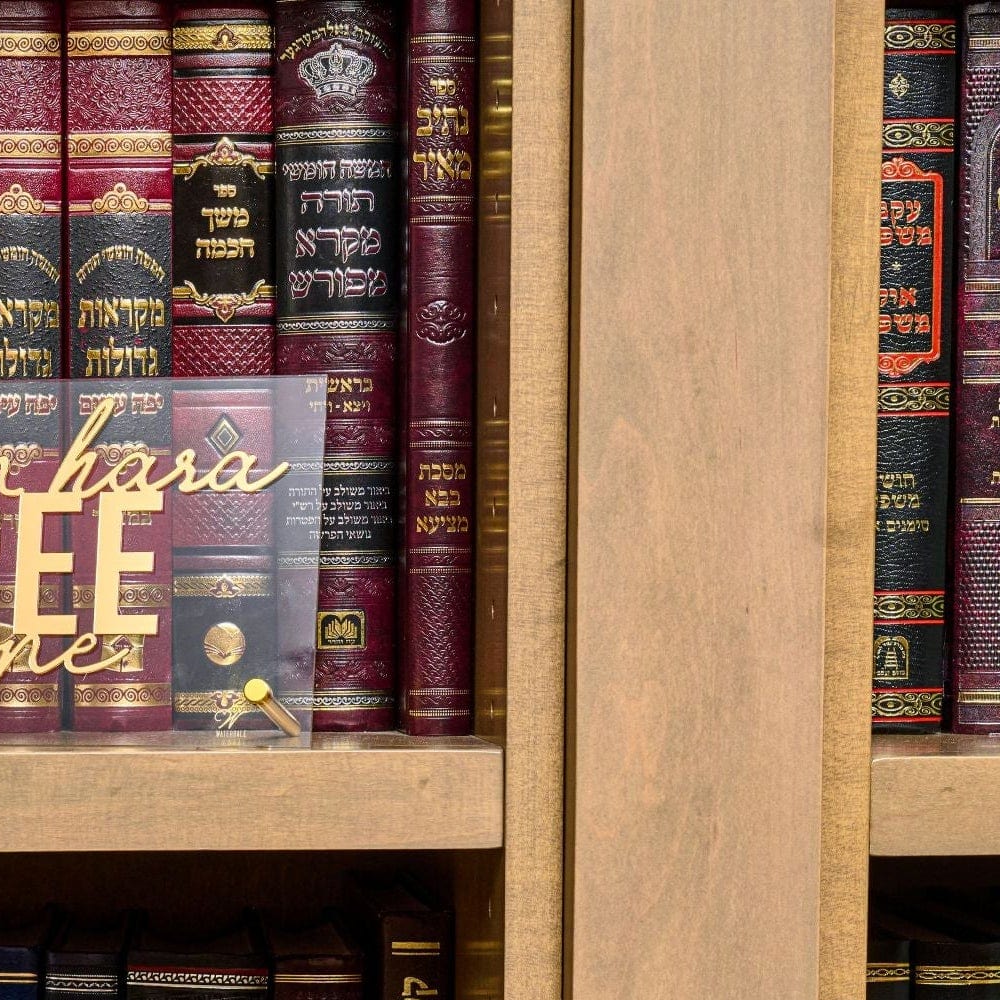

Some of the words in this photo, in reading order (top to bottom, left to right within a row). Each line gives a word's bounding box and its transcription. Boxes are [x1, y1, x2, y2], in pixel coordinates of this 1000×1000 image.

[300, 189, 375, 214] תורה
[201, 207, 250, 232] משך
[195, 237, 255, 259] חכמה
[295, 226, 382, 264] מקרא
[288, 268, 388, 299] מפורש
[77, 297, 165, 335] מקראות
[85, 336, 159, 377] גדולות
[48, 398, 289, 497] hara
